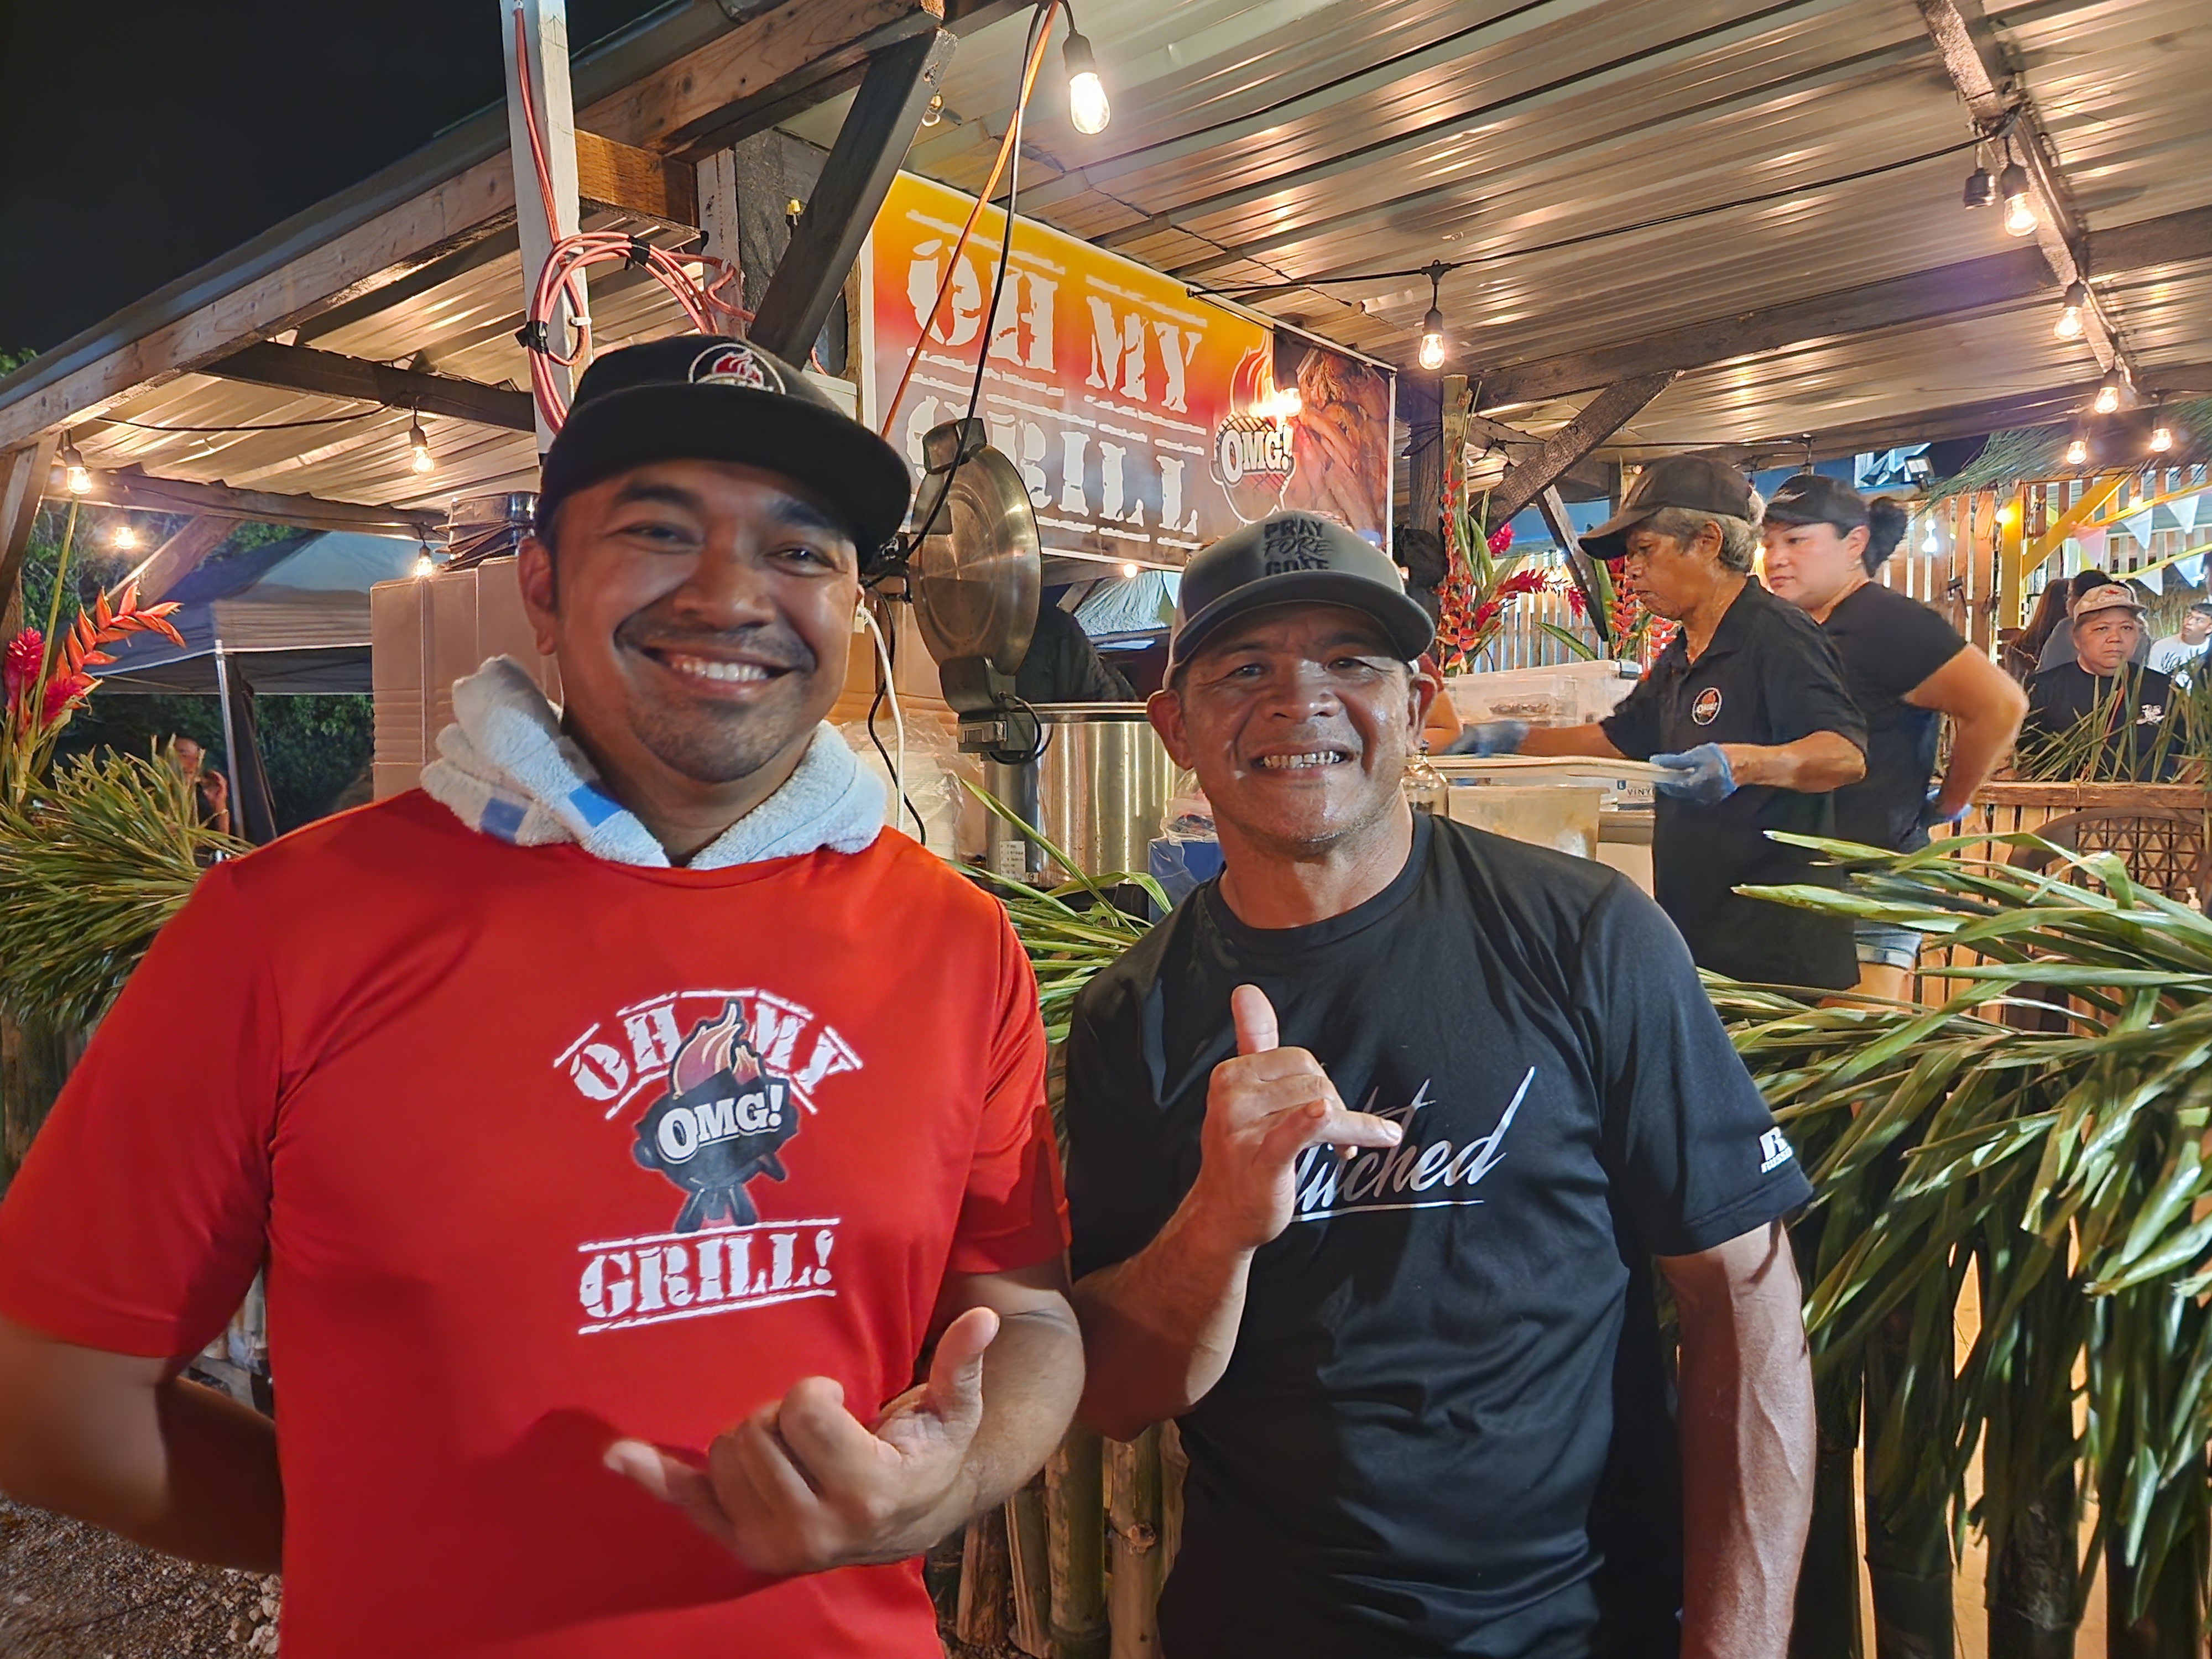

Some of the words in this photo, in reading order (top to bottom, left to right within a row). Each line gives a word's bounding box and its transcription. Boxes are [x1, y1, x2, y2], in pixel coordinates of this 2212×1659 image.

[906, 238, 1058, 374] OH
[1086, 295, 1203, 414] MY
[1220, 424, 1294, 483] OMG!
[1264, 518, 1323, 539] PRAY
[570, 1003, 682, 1100] OH
[748, 1001, 853, 1095] MY
[658, 1084, 784, 1161] OMG!
[1294, 1066, 1536, 1213] itched
[578, 1229, 834, 1319] GRILL!
